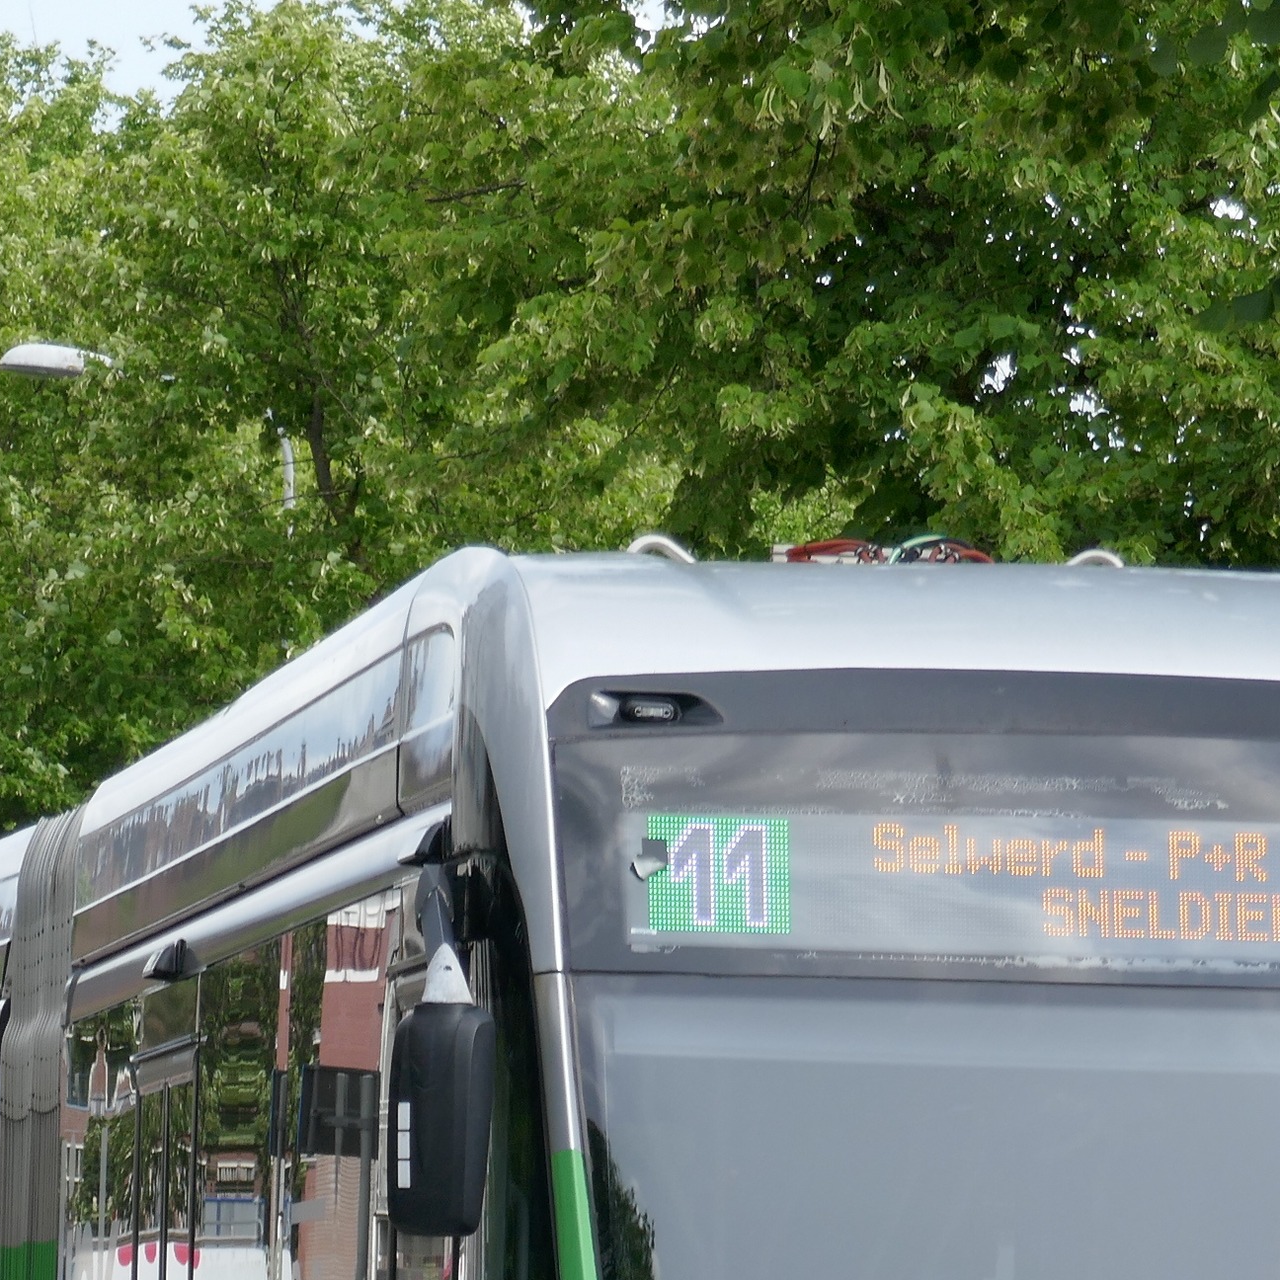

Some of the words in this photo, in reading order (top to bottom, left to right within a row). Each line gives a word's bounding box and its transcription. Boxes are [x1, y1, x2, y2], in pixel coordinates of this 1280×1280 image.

[669, 822, 768, 928] 11
[873, 823, 1105, 878] Selwerd
[1169, 831, 1269, 882] P+R
